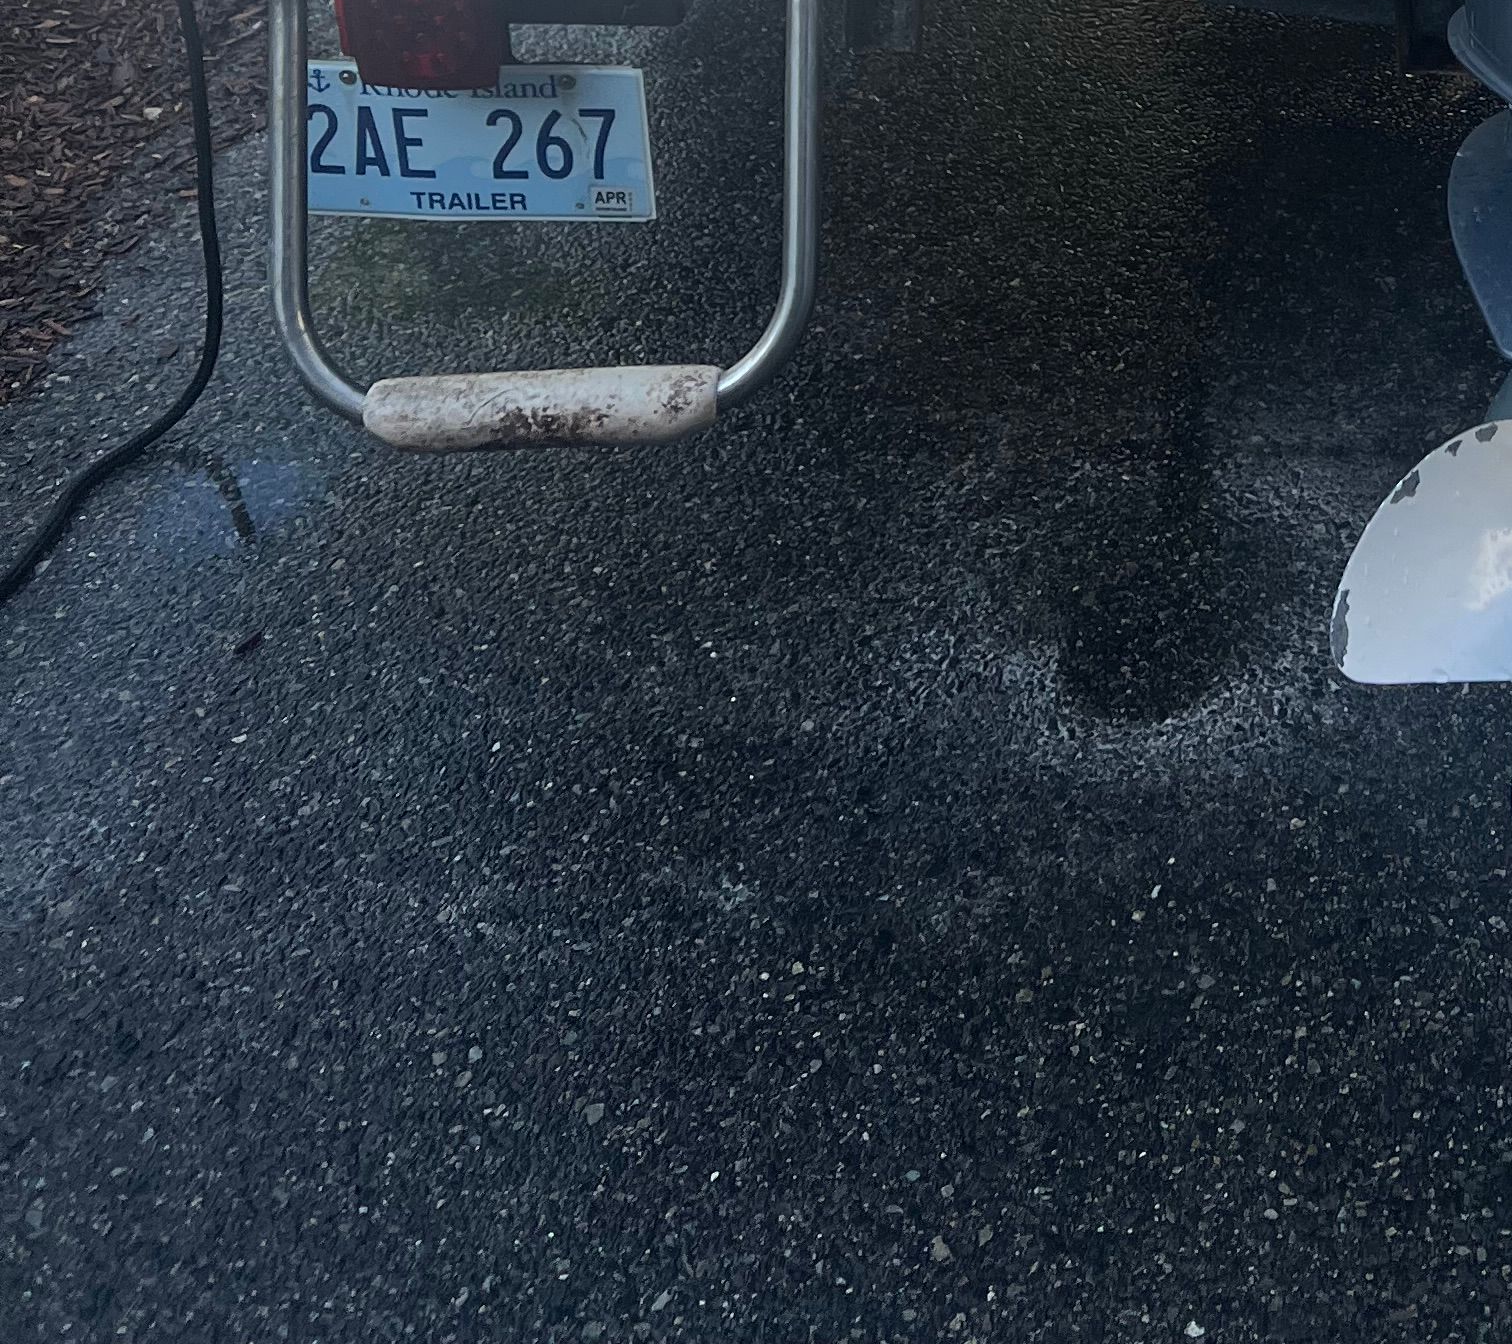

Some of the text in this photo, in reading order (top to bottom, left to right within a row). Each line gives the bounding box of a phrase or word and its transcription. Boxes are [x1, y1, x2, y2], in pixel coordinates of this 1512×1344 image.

[307, 103, 616, 179] 2AE 267
[409, 191, 528, 211] TRAILER
[594, 191, 627, 205] APR
